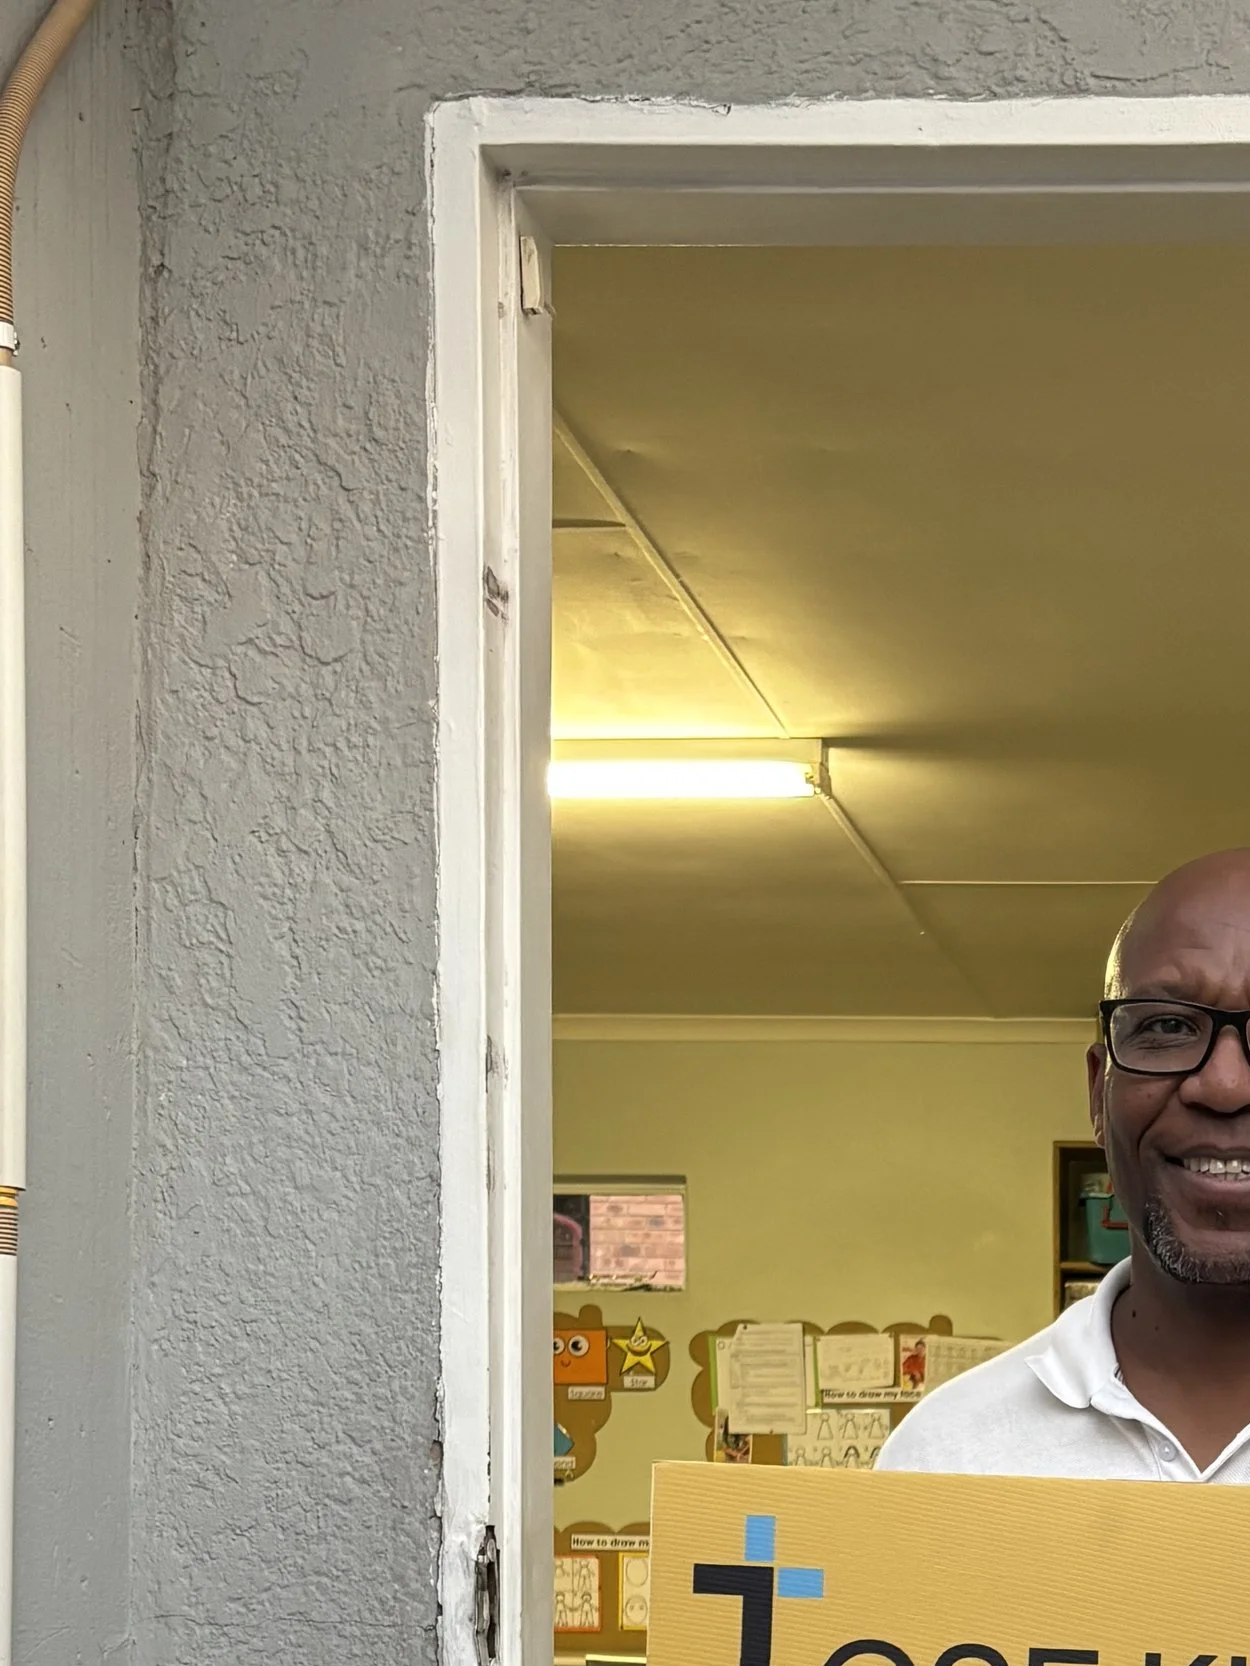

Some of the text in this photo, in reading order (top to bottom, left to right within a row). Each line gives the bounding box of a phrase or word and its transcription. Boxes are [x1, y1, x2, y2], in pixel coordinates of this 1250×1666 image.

[824, 1389, 845, 1399] How
[847, 1390, 857, 1399] to
[859, 1390, 882, 1399] draw
[883, 1391, 898, 1401] my
[572, 1537, 595, 1547] How
[597, 1538, 608, 1547] to
[610, 1538, 637, 1548] draw
